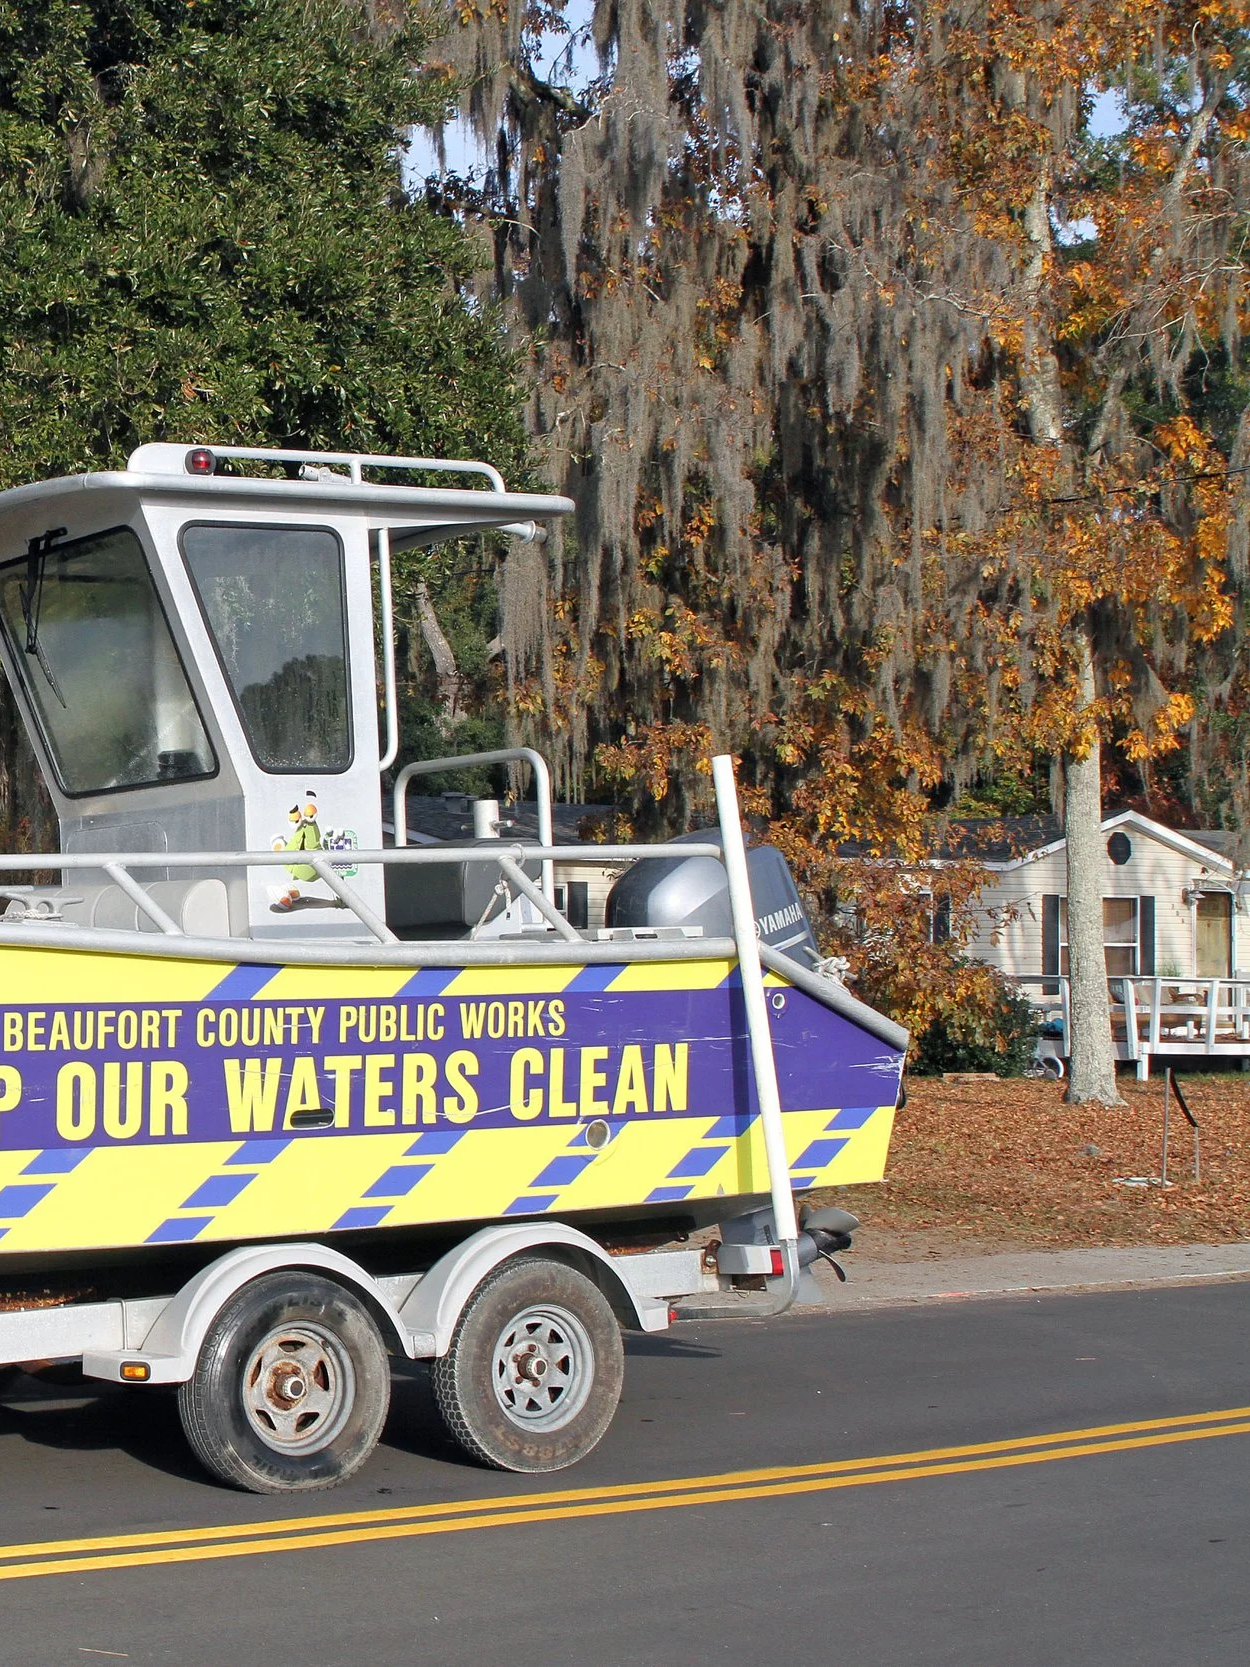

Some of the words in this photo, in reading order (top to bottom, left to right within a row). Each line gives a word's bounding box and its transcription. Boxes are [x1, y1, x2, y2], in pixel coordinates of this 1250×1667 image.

[758, 902, 803, 935] YAMAHA
[3, 1009, 182, 1052] BEAUFORT
[196, 1006, 326, 1048] COUNTY
[339, 1003, 445, 1044] PUBLIC
[459, 999, 566, 1039] WORKS
[56, 1060, 189, 1141] OUR
[223, 1049, 480, 1134] WATERS
[509, 1042, 689, 1121] CLEAN
